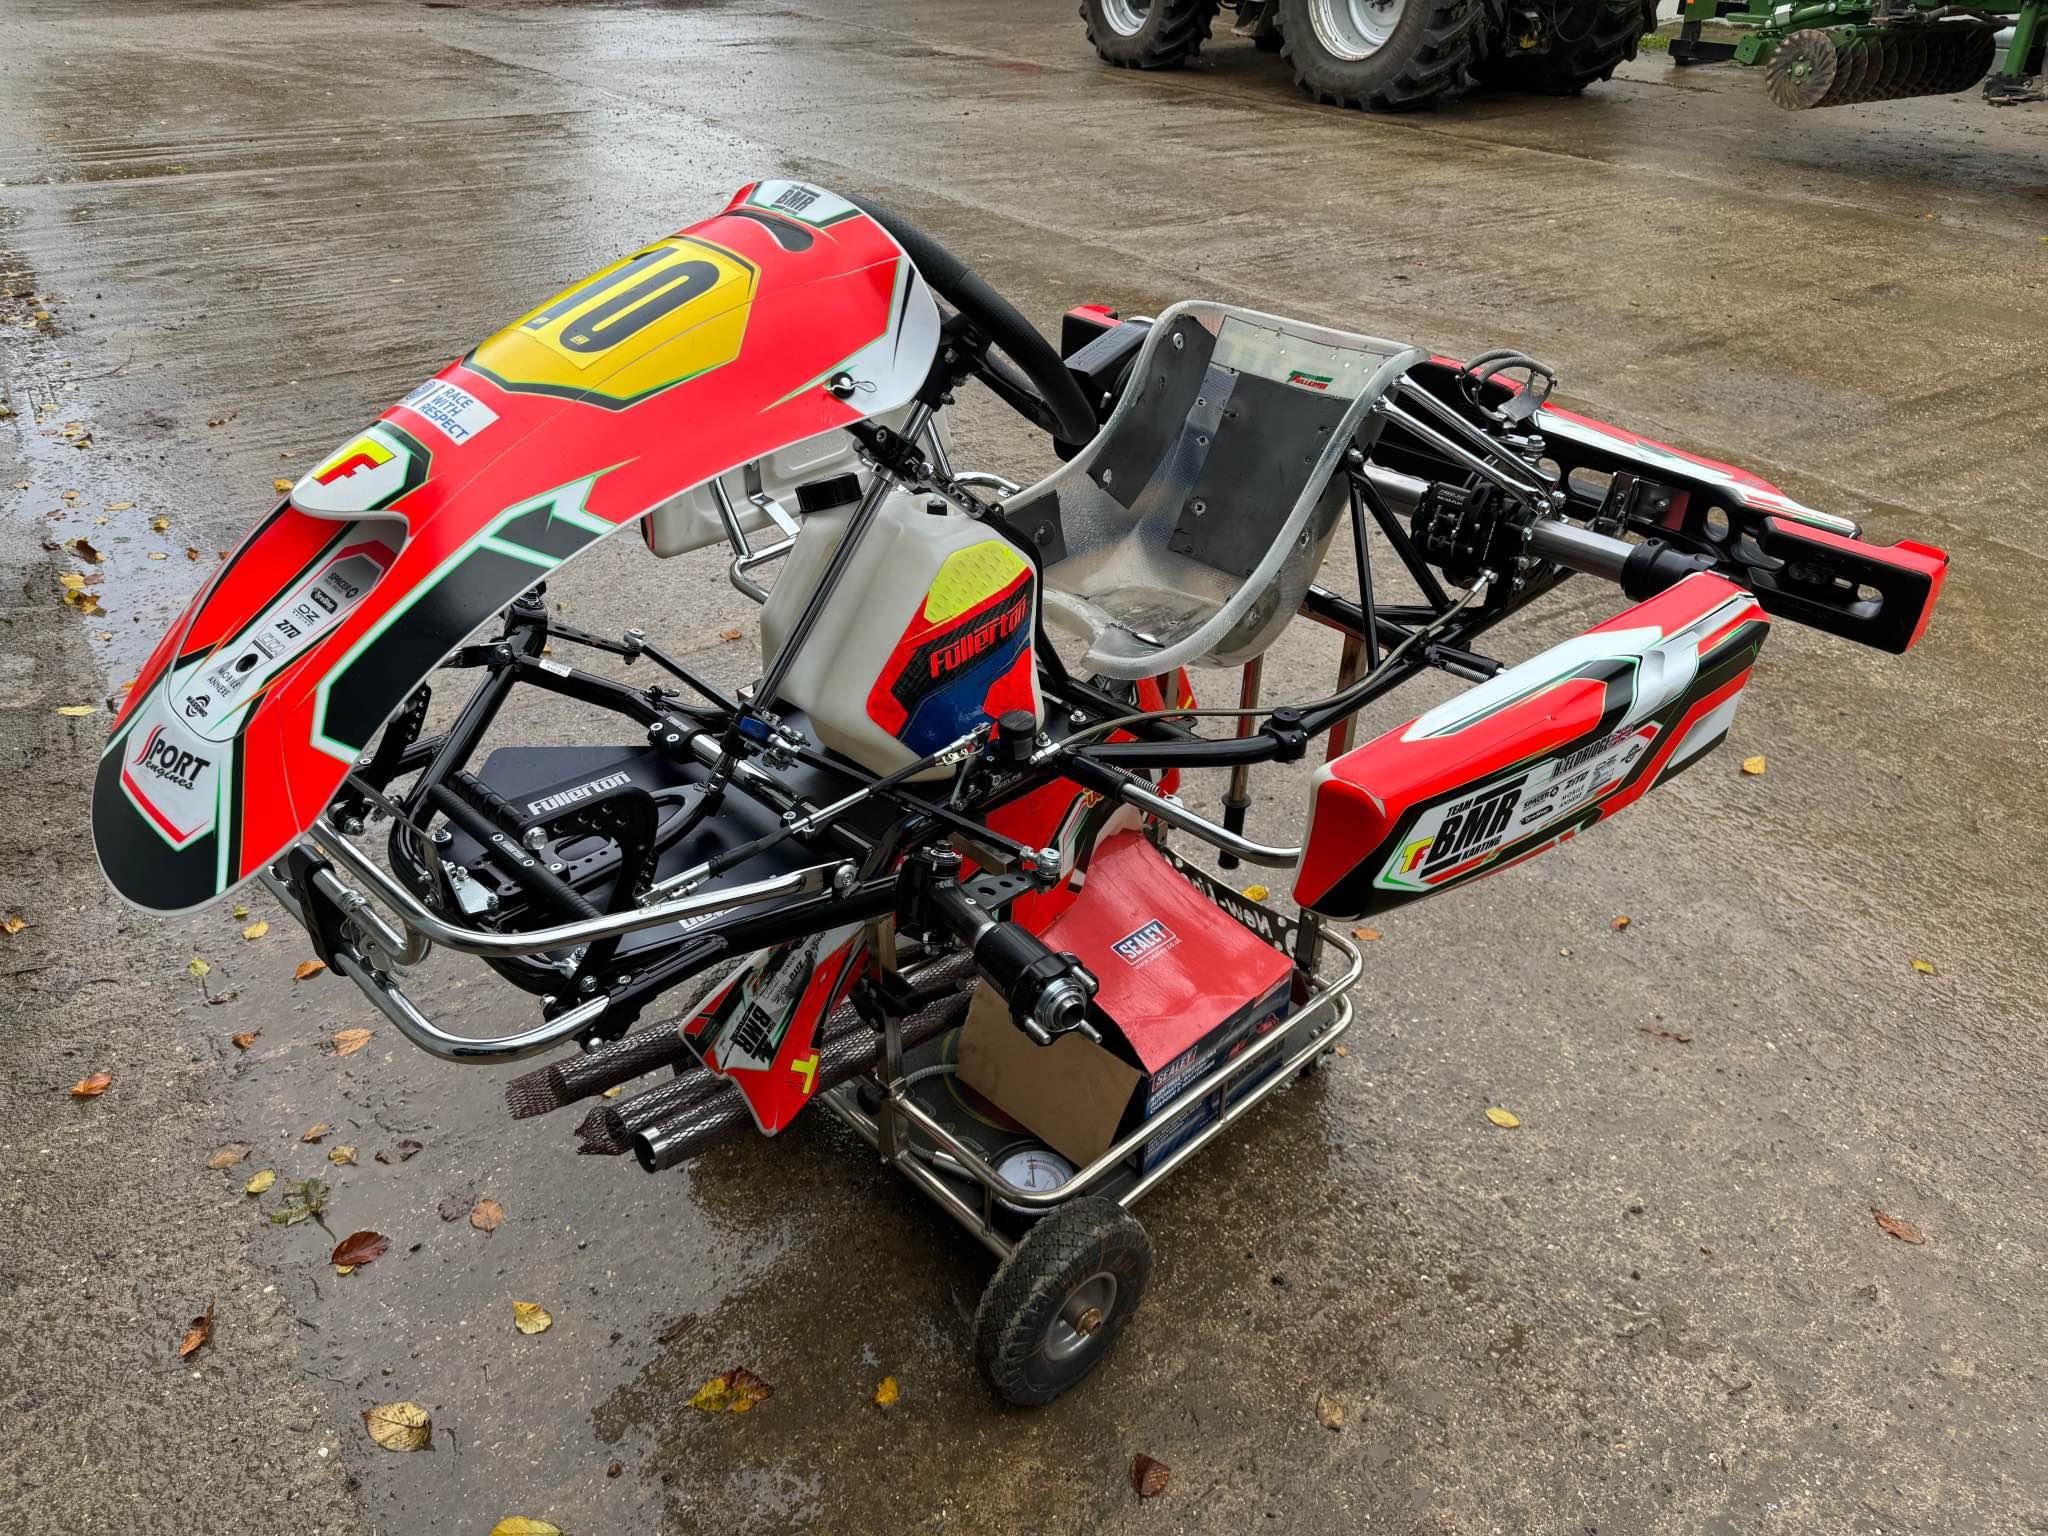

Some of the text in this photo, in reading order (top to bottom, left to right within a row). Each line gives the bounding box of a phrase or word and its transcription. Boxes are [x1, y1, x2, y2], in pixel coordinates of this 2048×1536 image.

[773, 188, 816, 212] BMR
[430, 395, 463, 417] WITH
[442, 387, 474, 409] RACE
[419, 402, 470, 439] RESPECT
[327, 572, 352, 591] SPACER
[298, 603, 320, 622] OZ
[929, 593, 1028, 679] Fullerton
[208, 676, 231, 698] ANNEXE
[217, 667, 241, 690] MOBILE
[186, 695, 209, 718] MASSIMO
[132, 724, 212, 781] SPORT
[145, 760, 196, 790] engines
[527, 771, 633, 816] Fullerton
[1523, 791, 1550, 809] SPACER
[1558, 792, 1583, 809] ANNEXE
[1561, 785, 1586, 801] MOBILE
[1446, 798, 1475, 818] TEAM
[1424, 788, 1522, 866] BMR
[1461, 834, 1503, 861] KARTING
[1118, 924, 1168, 960] SEALEY
[736, 1004, 773, 1055] BMR
[1156, 1051, 1194, 1084] SEALEY
